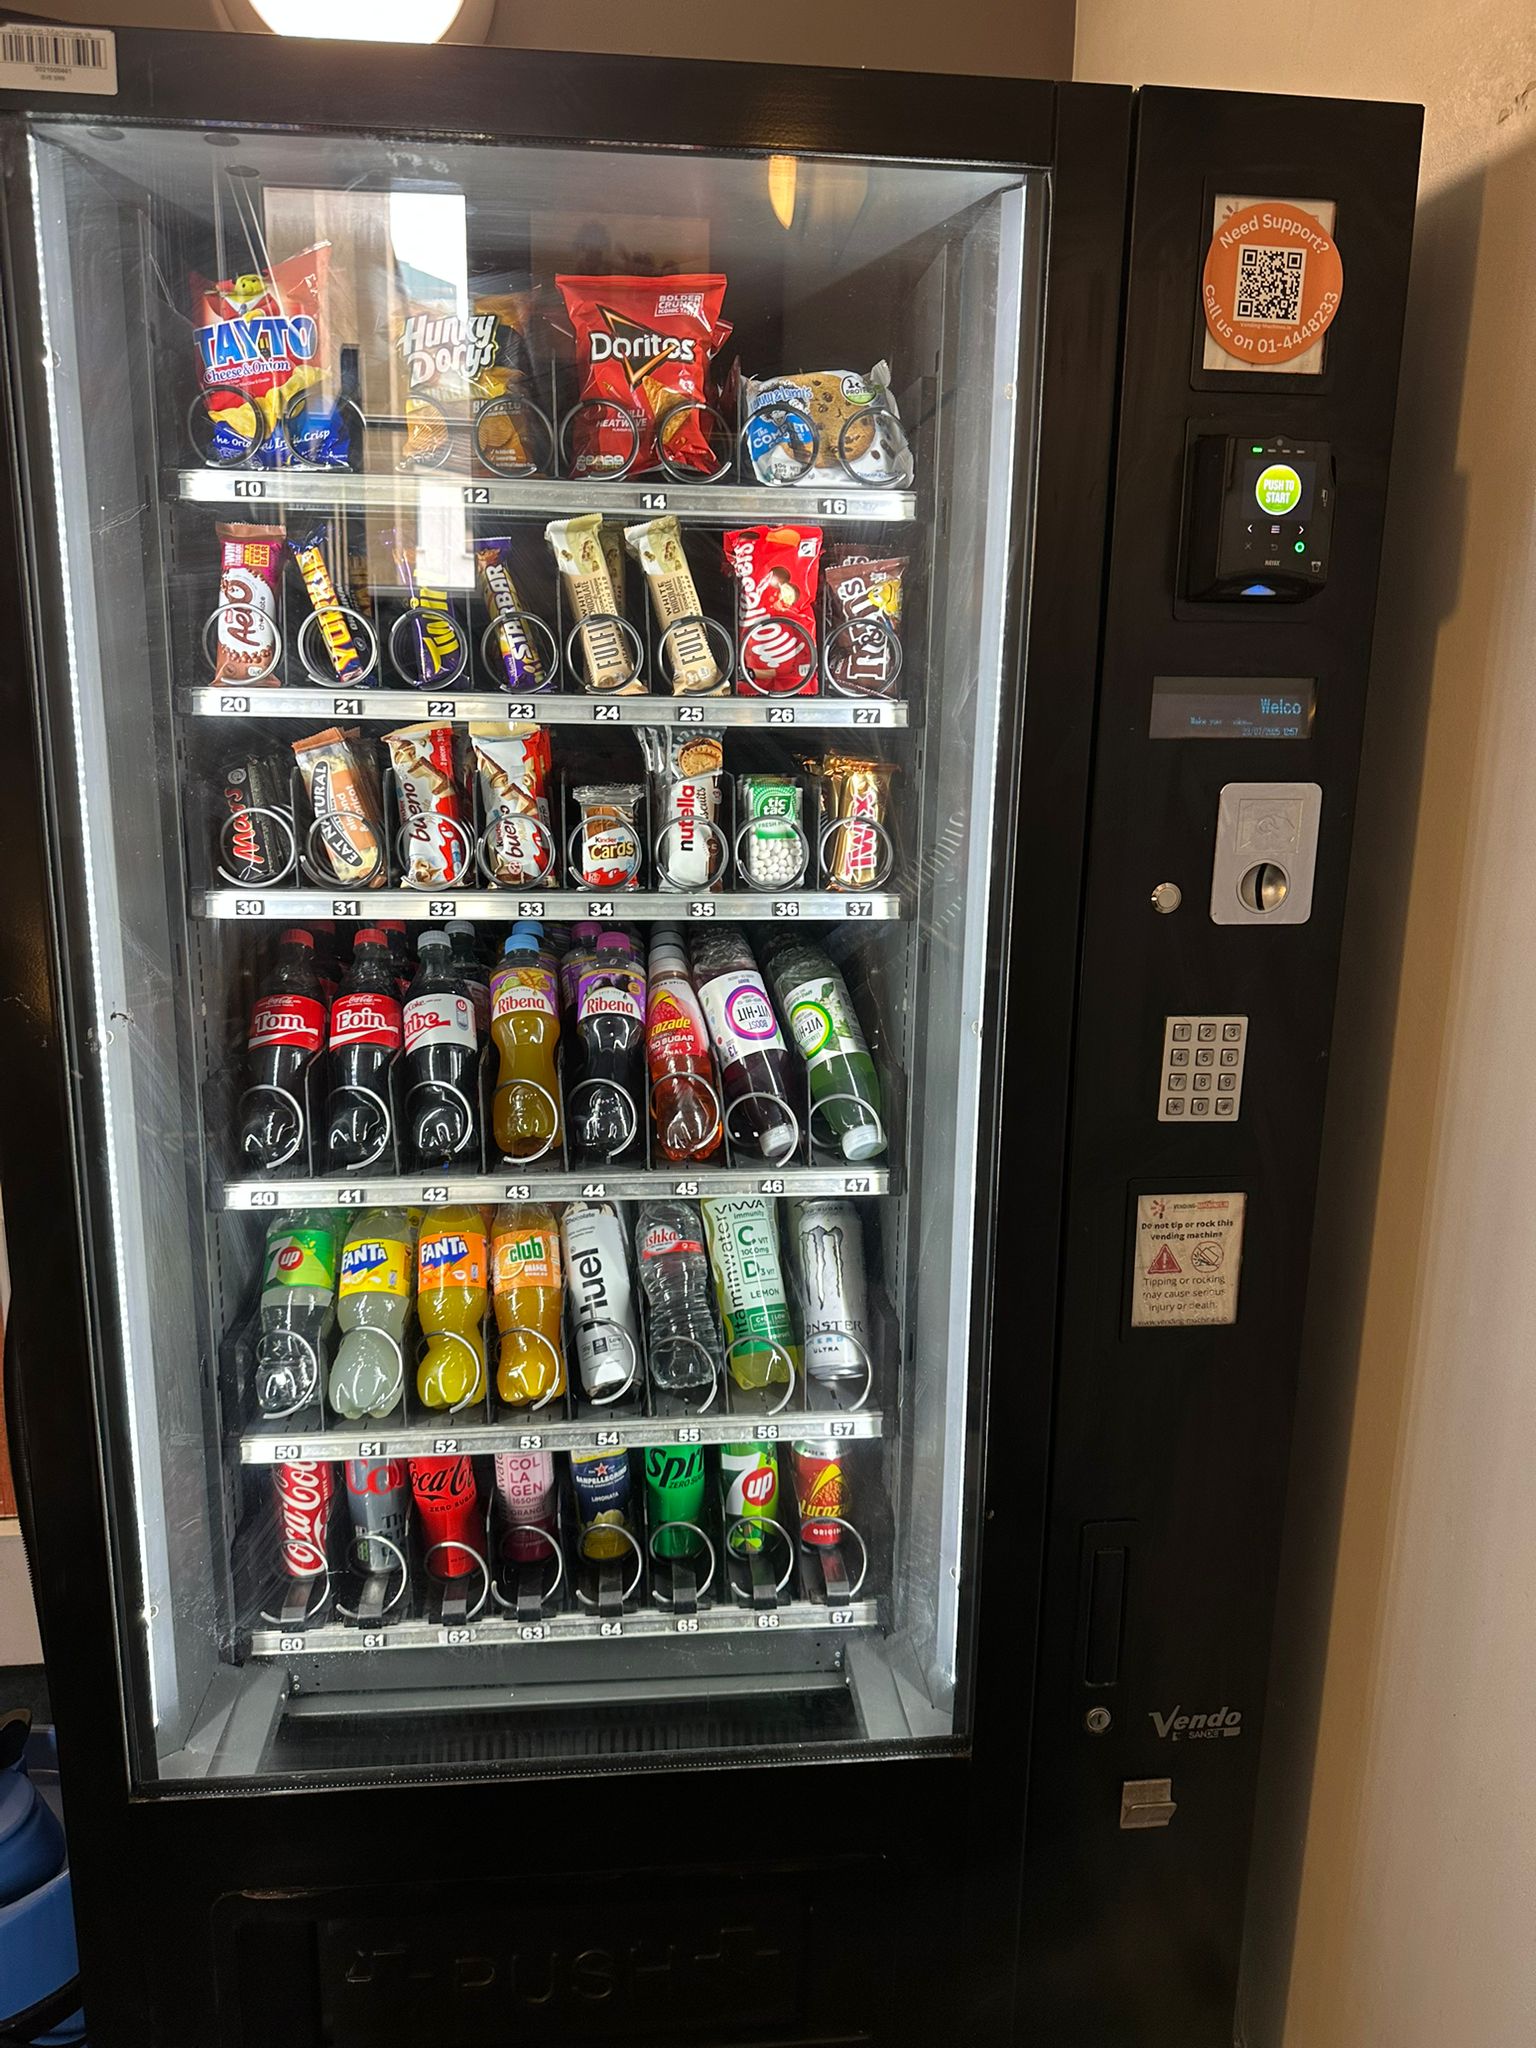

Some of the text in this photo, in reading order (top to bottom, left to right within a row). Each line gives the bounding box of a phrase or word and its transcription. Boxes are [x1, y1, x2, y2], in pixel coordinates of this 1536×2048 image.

[1219, 213, 1330, 254] Need Support?
[658, 294, 702, 302] BOLDER
[1216, 291, 1339, 353] us on 01-4448233
[193, 314, 317, 369] TAYTO
[396, 314, 496, 356] Hunky
[590, 332, 696, 362] Doritos
[407, 342, 497, 388] Dorys
[597, 417, 647, 428] HEATWVE
[304, 429, 331, 442] Crisp
[1263, 479, 1295, 491] PUSH TO
[236, 481, 847, 514] 10 12 14 16
[1265, 492, 1291, 504] START
[573, 582, 588, 619] WHITE
[657, 582, 671, 617] WHITE
[664, 579, 682, 614] CHOCOLATE
[485, 563, 534, 661] STARBAR
[222, 698, 879, 723] 20 21 22 23 24 25 26 27
[1260, 698, 1302, 714] Welco
[768, 796, 787, 807] tic
[403, 782, 431, 842] bueno
[763, 804, 786, 816] tac
[225, 786, 265, 864] Mars
[676, 785, 696, 852] nutella
[332, 836, 359, 863] EAT
[590, 840, 636, 861] Cards
[237, 901, 871, 916] 30 31 32 33 34 35 36 37
[498, 996, 546, 1014] Ribena
[587, 999, 634, 1014] Ribena
[255, 1011, 305, 1033] Tom
[336, 1007, 387, 1033] Eoin
[1180, 1028, 1236, 1037] 1 2 3
[661, 1035, 695, 1048] SUGAR
[728, 1043, 738, 1057] 13
[1176, 1053, 1233, 1062] 4 5 6
[1174, 1077, 1231, 1087] 7 8 9
[1197, 1102, 1204, 1111] 0
[251, 1179, 867, 1205] 40 41 42 43 44 45 46 47
[1154, 1222, 1169, 1230] not
[1171, 1222, 1183, 1231] tip
[1196, 1220, 1216, 1228] rock
[1217, 1219, 1234, 1227] this
[1150, 1231, 1223, 1241] vending machine
[341, 1242, 387, 1271] FANTA
[421, 1236, 468, 1264] FANTA
[509, 1235, 544, 1263] club
[1143, 1277, 1177, 1287] Tipping
[1191, 1276, 1226, 1285] rocking
[571, 1248, 611, 1333] Huel
[750, 1287, 780, 1299] LEMON
[1142, 1288, 1225, 1300] may cause serious
[1148, 1302, 1175, 1313] injury
[806, 1320, 864, 1336] ONSTER
[813, 1346, 840, 1354] ULTRA
[275, 1423, 853, 1459] 50 51 52 53 54 55 56 57
[509, 1456, 541, 1471] COL
[510, 1472, 530, 1484] LA
[669, 1478, 690, 1489] ZERO
[511, 1481, 543, 1497] GEN
[429, 1504, 452, 1513] ZERO
[281, 1612, 852, 1651] 60 61 62 63 64 65 66 67
[1148, 1704, 1242, 1738] Vendo
